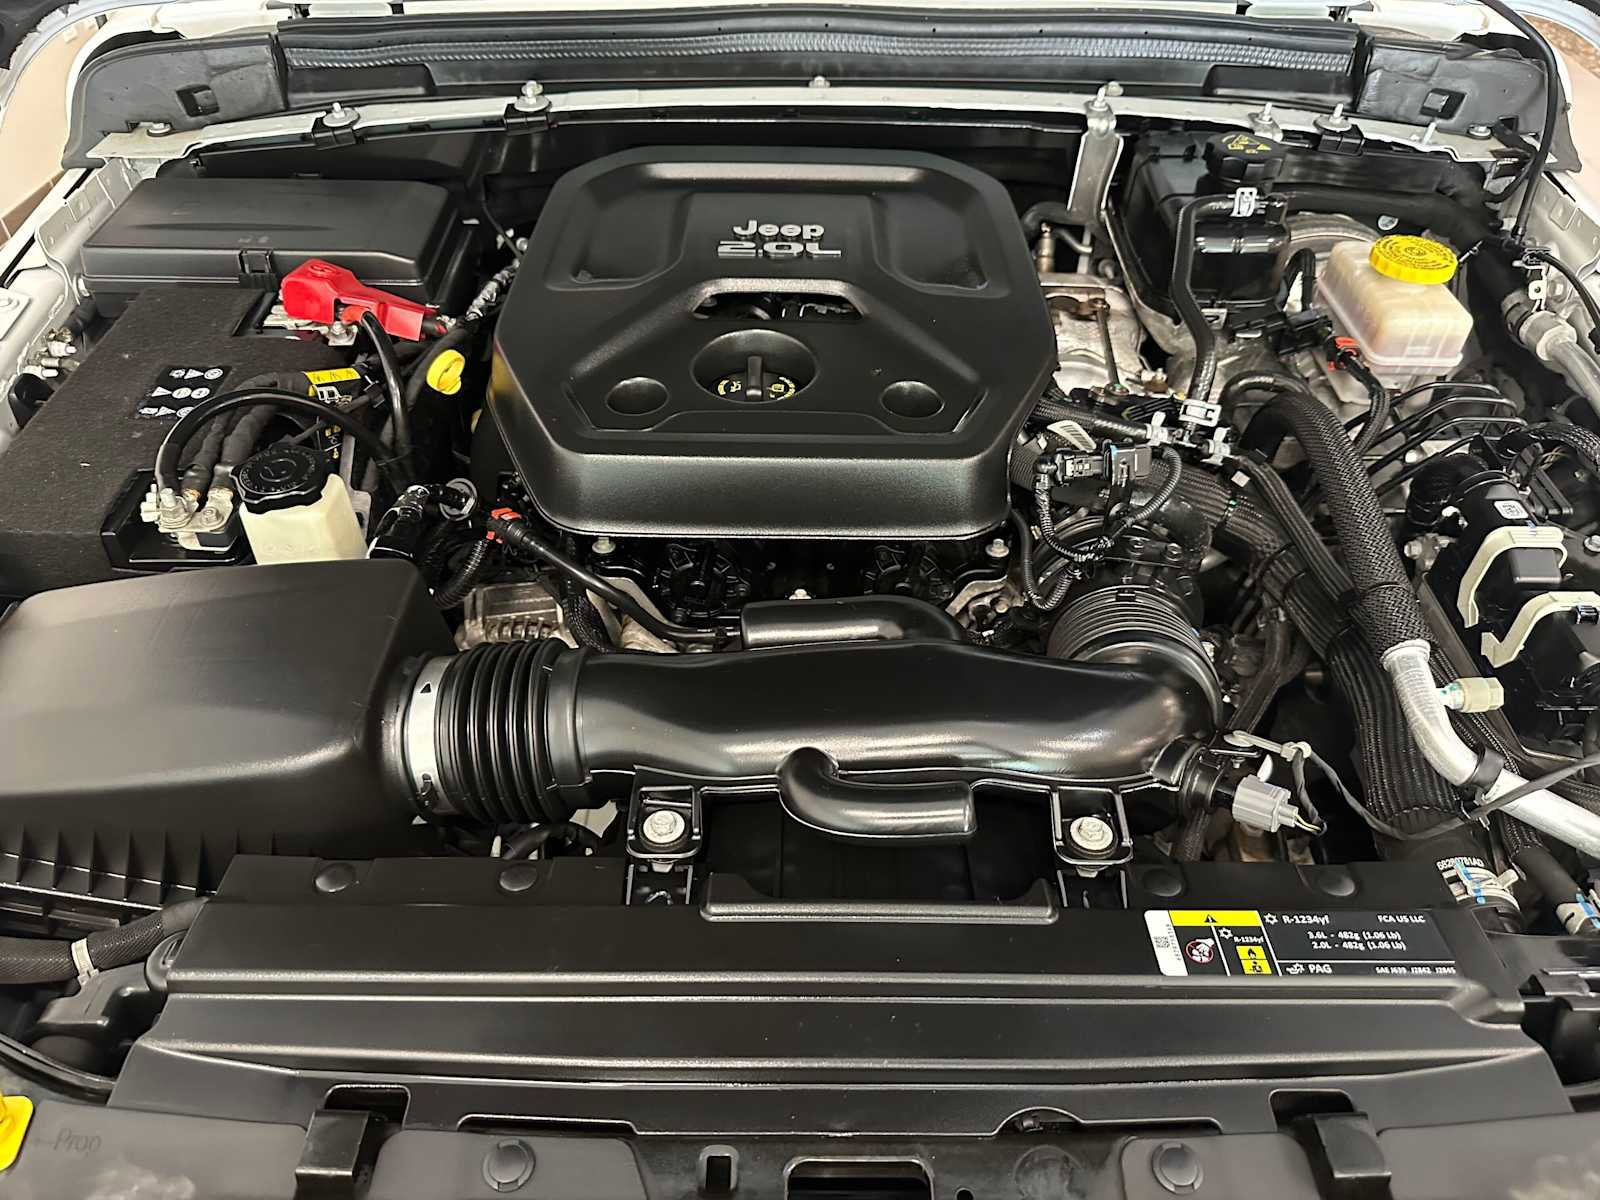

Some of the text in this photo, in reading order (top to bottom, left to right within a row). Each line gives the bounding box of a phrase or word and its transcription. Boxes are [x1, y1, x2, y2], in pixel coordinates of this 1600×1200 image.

[733, 220, 824, 239] Jeep
[718, 240, 841, 257] 2.0L
[1282, 915, 1330, 925] R-1234yf
[1377, 915, 1426, 923] FCA US LLC
[1338, 931, 1360, 941] 482g
[1311, 941, 1332, 949] 2.0L
[1342, 941, 1365, 951] 482g
[1308, 964, 1332, 974] PAG
